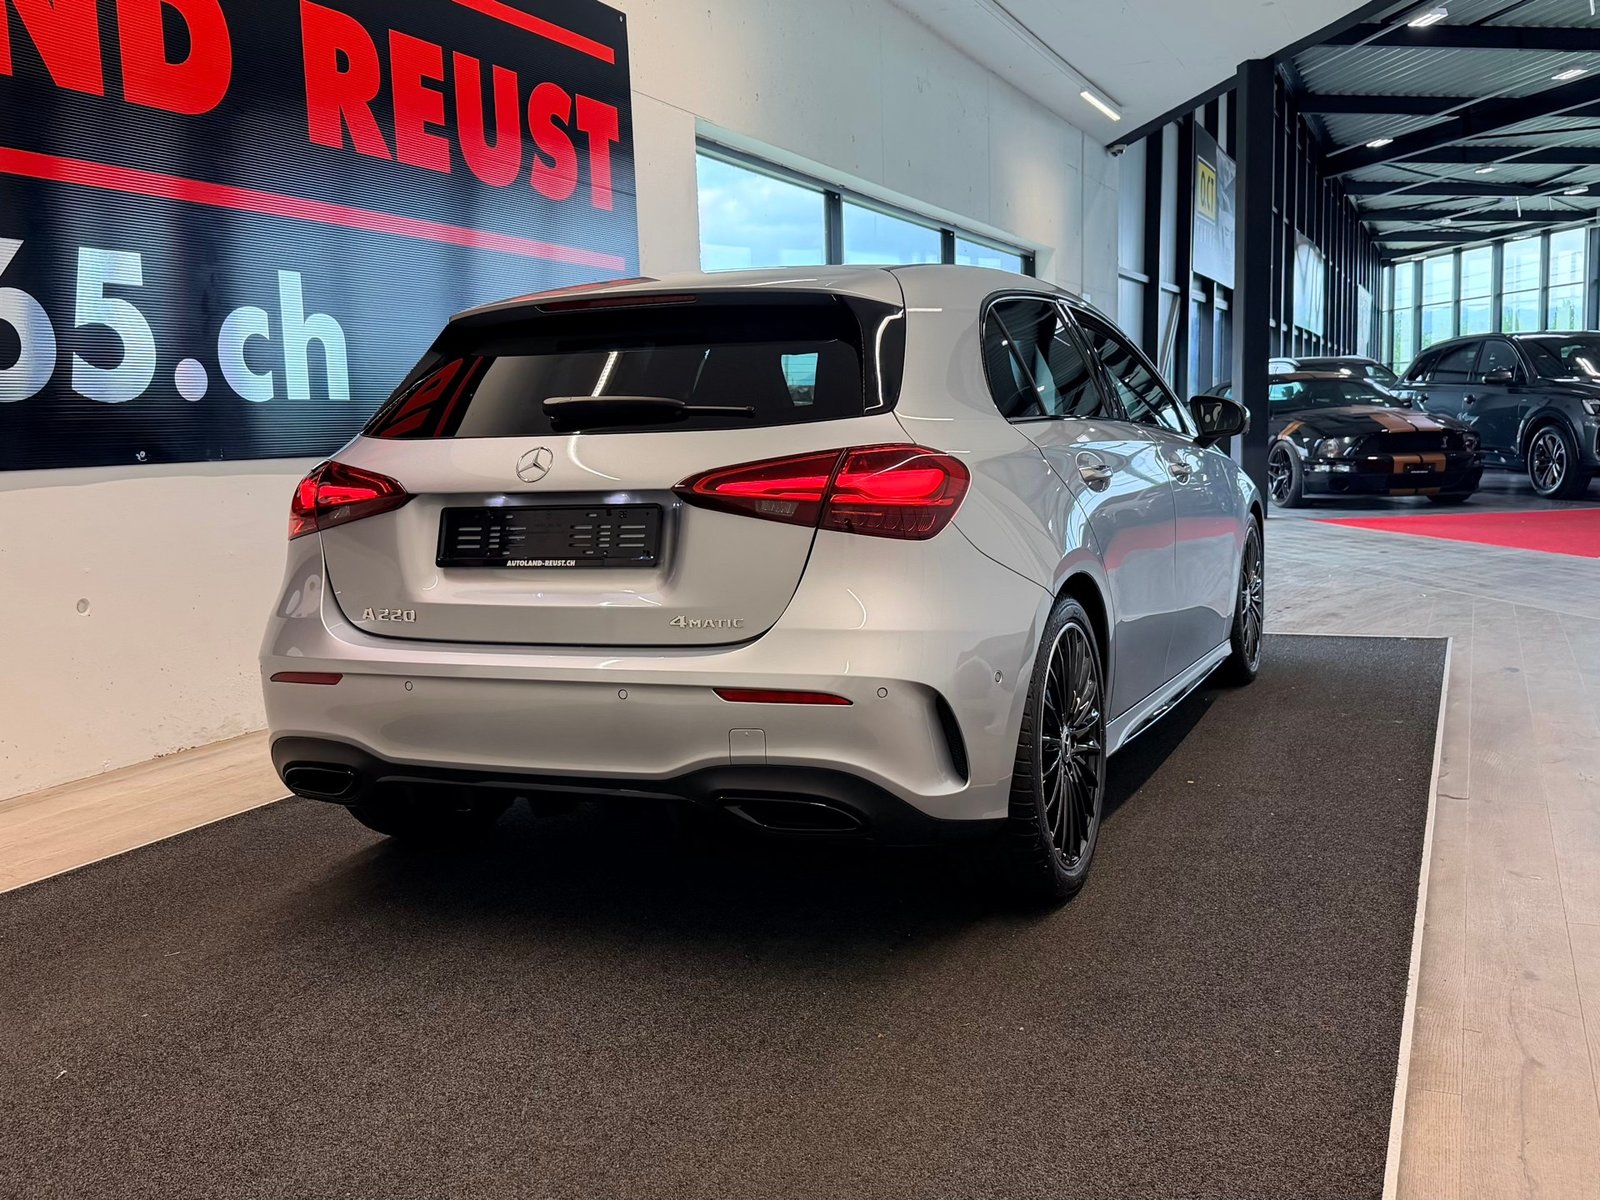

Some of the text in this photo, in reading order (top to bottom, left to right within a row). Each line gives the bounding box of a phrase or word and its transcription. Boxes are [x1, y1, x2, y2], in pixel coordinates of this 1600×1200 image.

[300, 0, 619, 211] REUST
[506, 559, 576, 567] AUTOLAND-REUST.CH
[669, 615, 744, 628] 4MATIC
